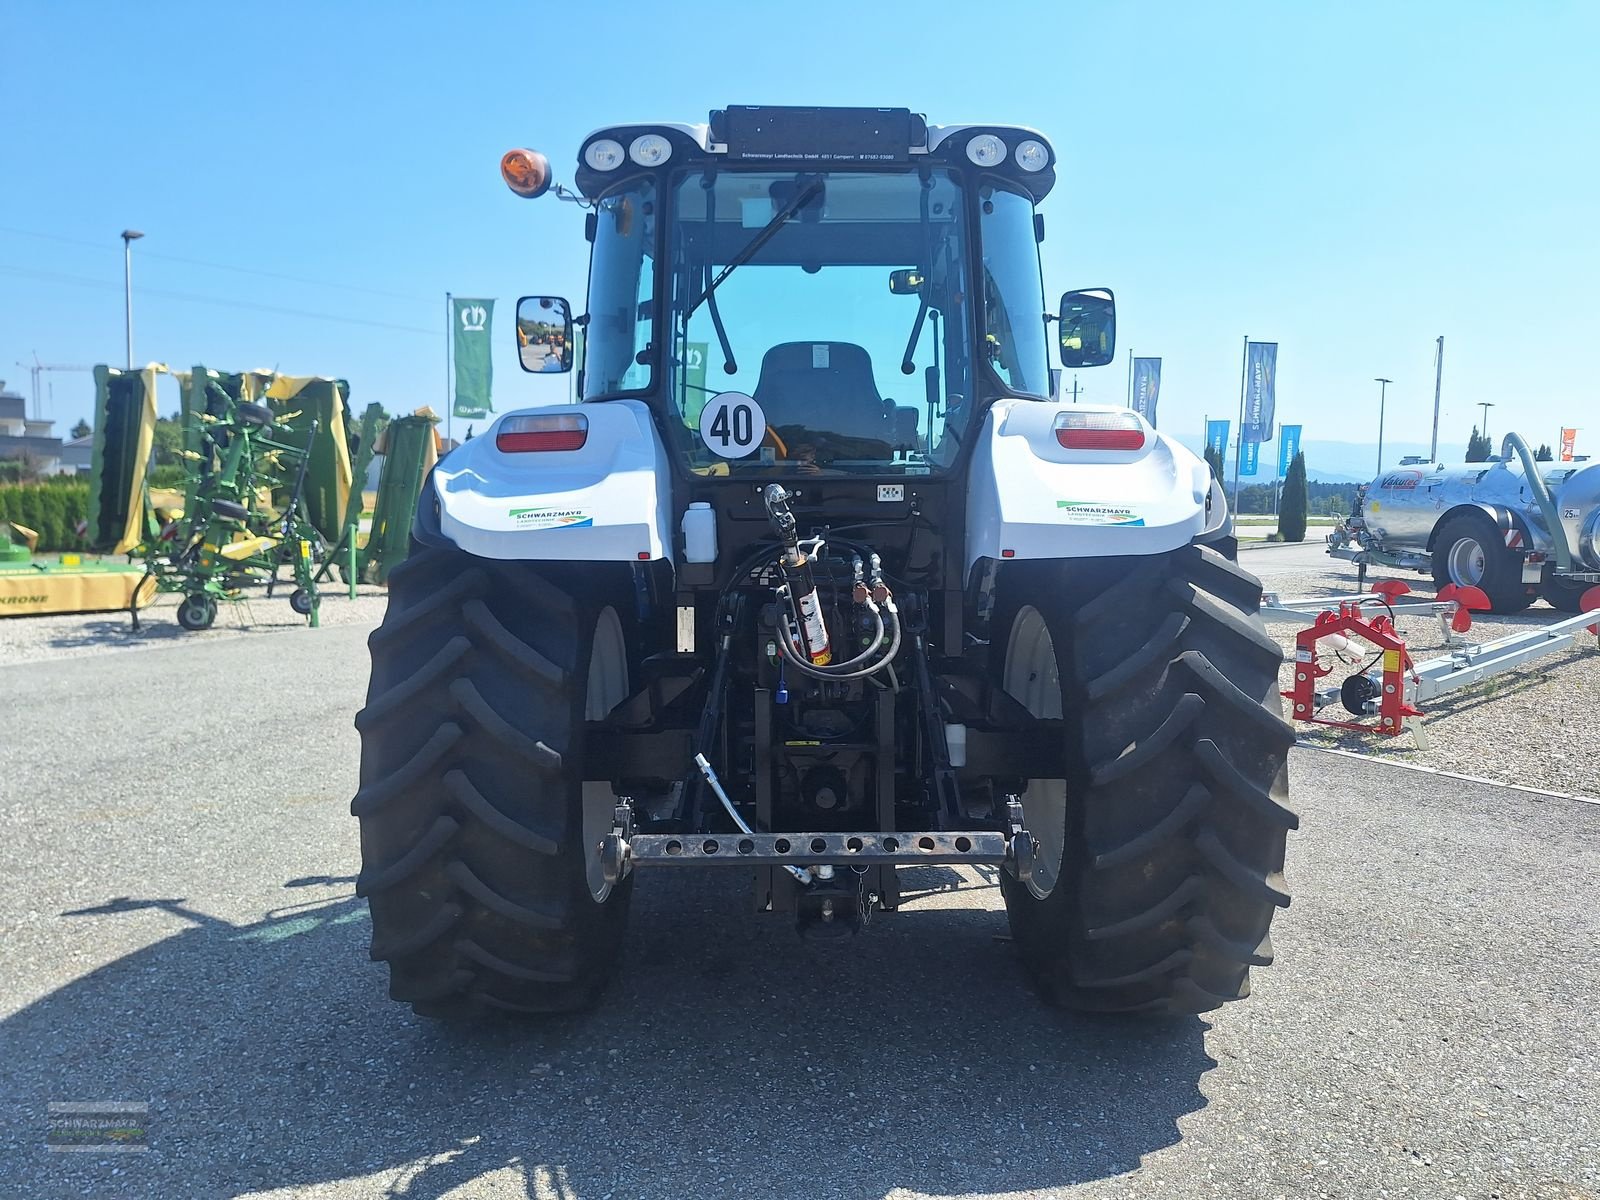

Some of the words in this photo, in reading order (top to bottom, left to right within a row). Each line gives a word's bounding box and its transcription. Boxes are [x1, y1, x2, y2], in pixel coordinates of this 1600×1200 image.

[710, 404, 752, 447] 40
[1380, 475, 1419, 489] Vakutec
[517, 510, 582, 519] SCHWARZMAYR
[1066, 506, 1131, 514] SCHWARZMAYR
[1564, 509, 1574, 518] 25
